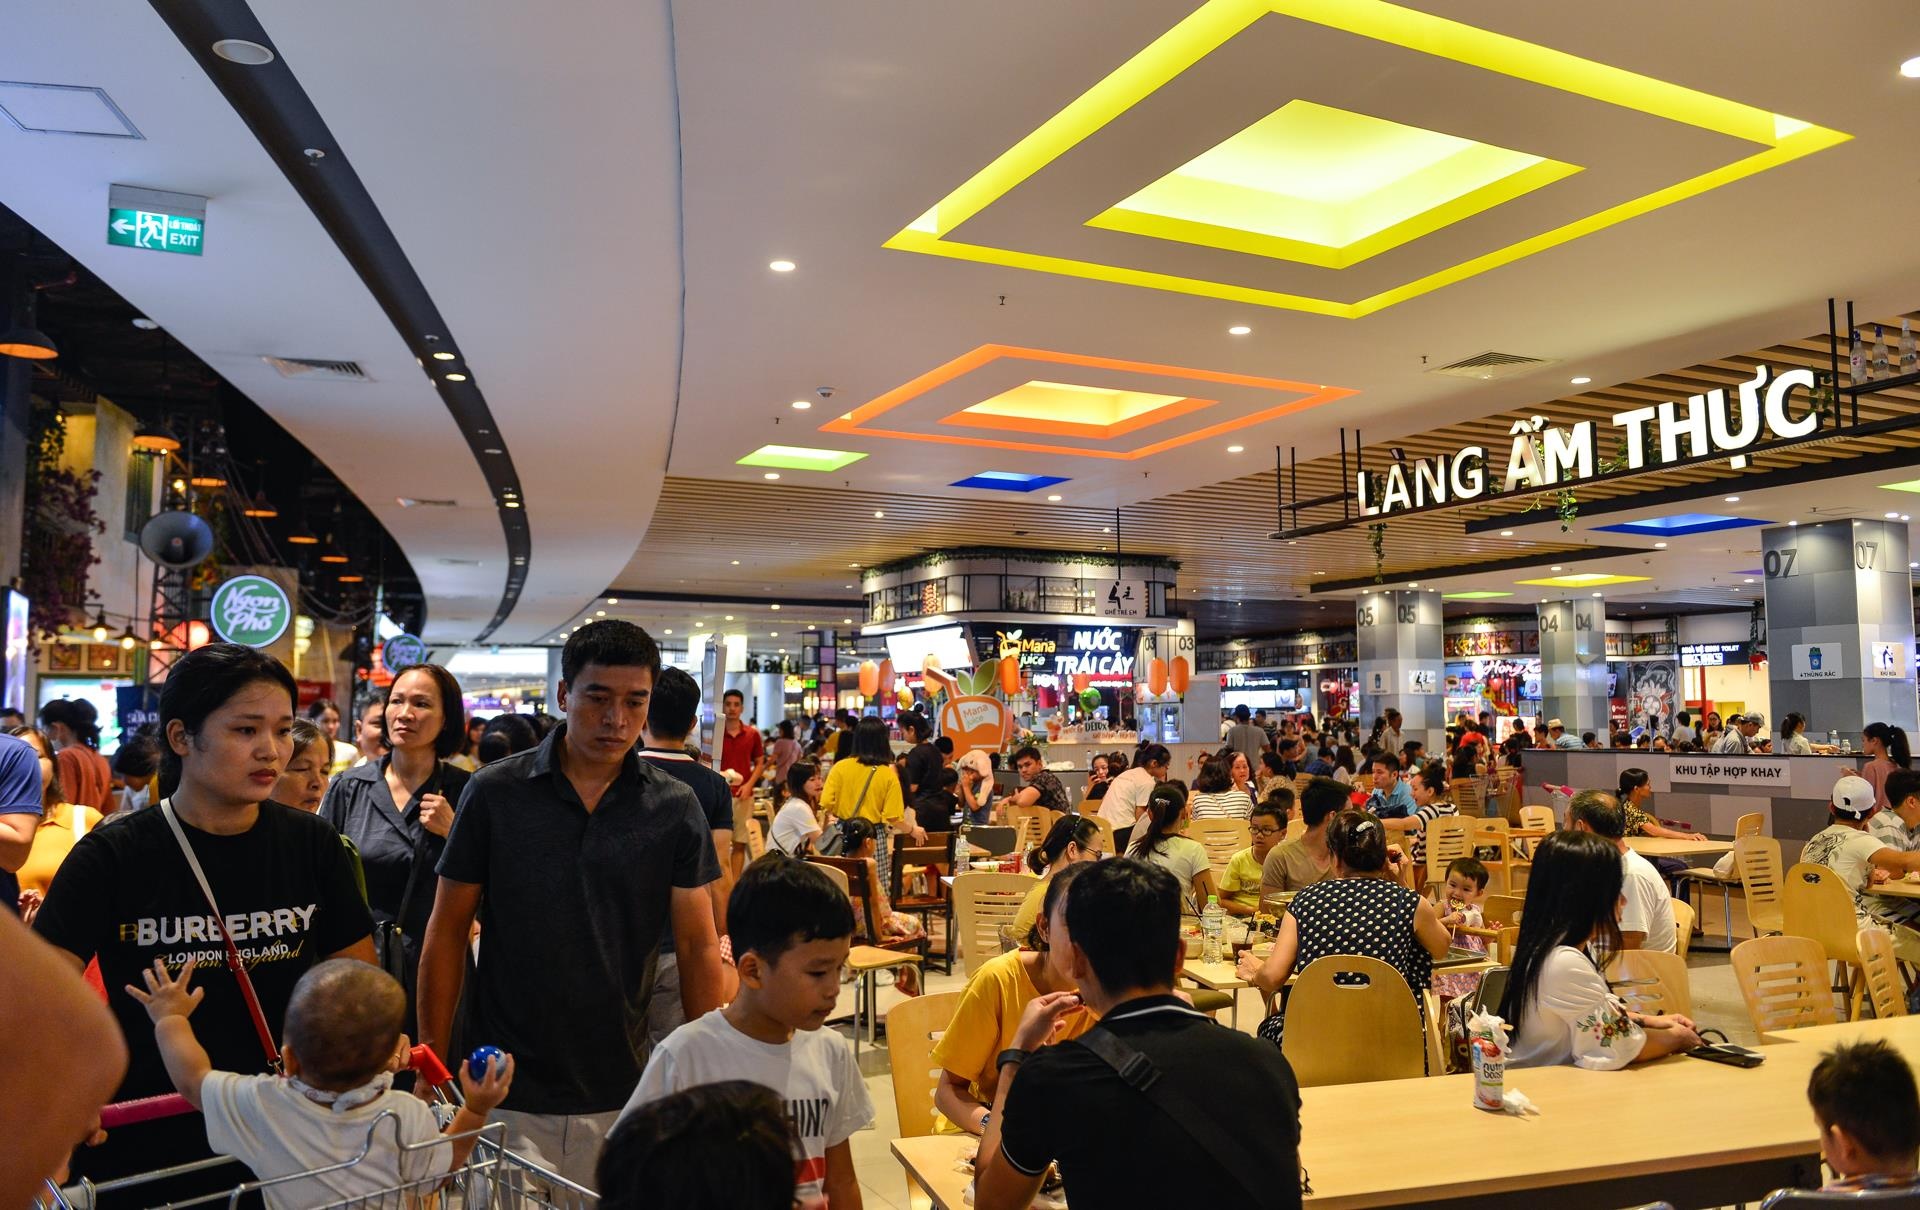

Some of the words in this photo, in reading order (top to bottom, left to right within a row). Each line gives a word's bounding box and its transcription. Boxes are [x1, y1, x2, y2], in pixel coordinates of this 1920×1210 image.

[170, 233, 199, 247] EXIT
[1357, 446, 1490, 518] LÀNG
[1503, 415, 1598, 494] ẨM
[1612, 364, 1822, 471] THỰC
[1763, 549, 1797, 578] 07
[1855, 541, 1879, 570] 07
[223, 584, 281, 613] Ngon
[1358, 607, 1374, 626] 05
[1398, 604, 1416, 624] 05
[1576, 613, 1593, 632] 04
[1540, 615, 1559, 633] 04
[1021, 638, 1056, 653] Mana
[1073, 626, 1123, 651] NƯỚC
[1144, 637, 1156, 651] 03
[1179, 636, 1194, 651] 03
[1019, 652, 1046, 669] juice
[1054, 651, 1097, 675] TRÁI
[1098, 652, 1135, 676] CÂY
[1219, 673, 1245, 687] OTTO
[1804, 670, 1823, 678] THÙNG
[962, 704, 989, 718] Mana
[1675, 765, 1698, 775] KHU
[1700, 763, 1721, 779] TẬP
[1723, 766, 1748, 779] HỢP
[1751, 767, 1782, 778] KHAY
[137, 904, 317, 946] BURBERRY
[168, 950, 223, 964] LONDON
